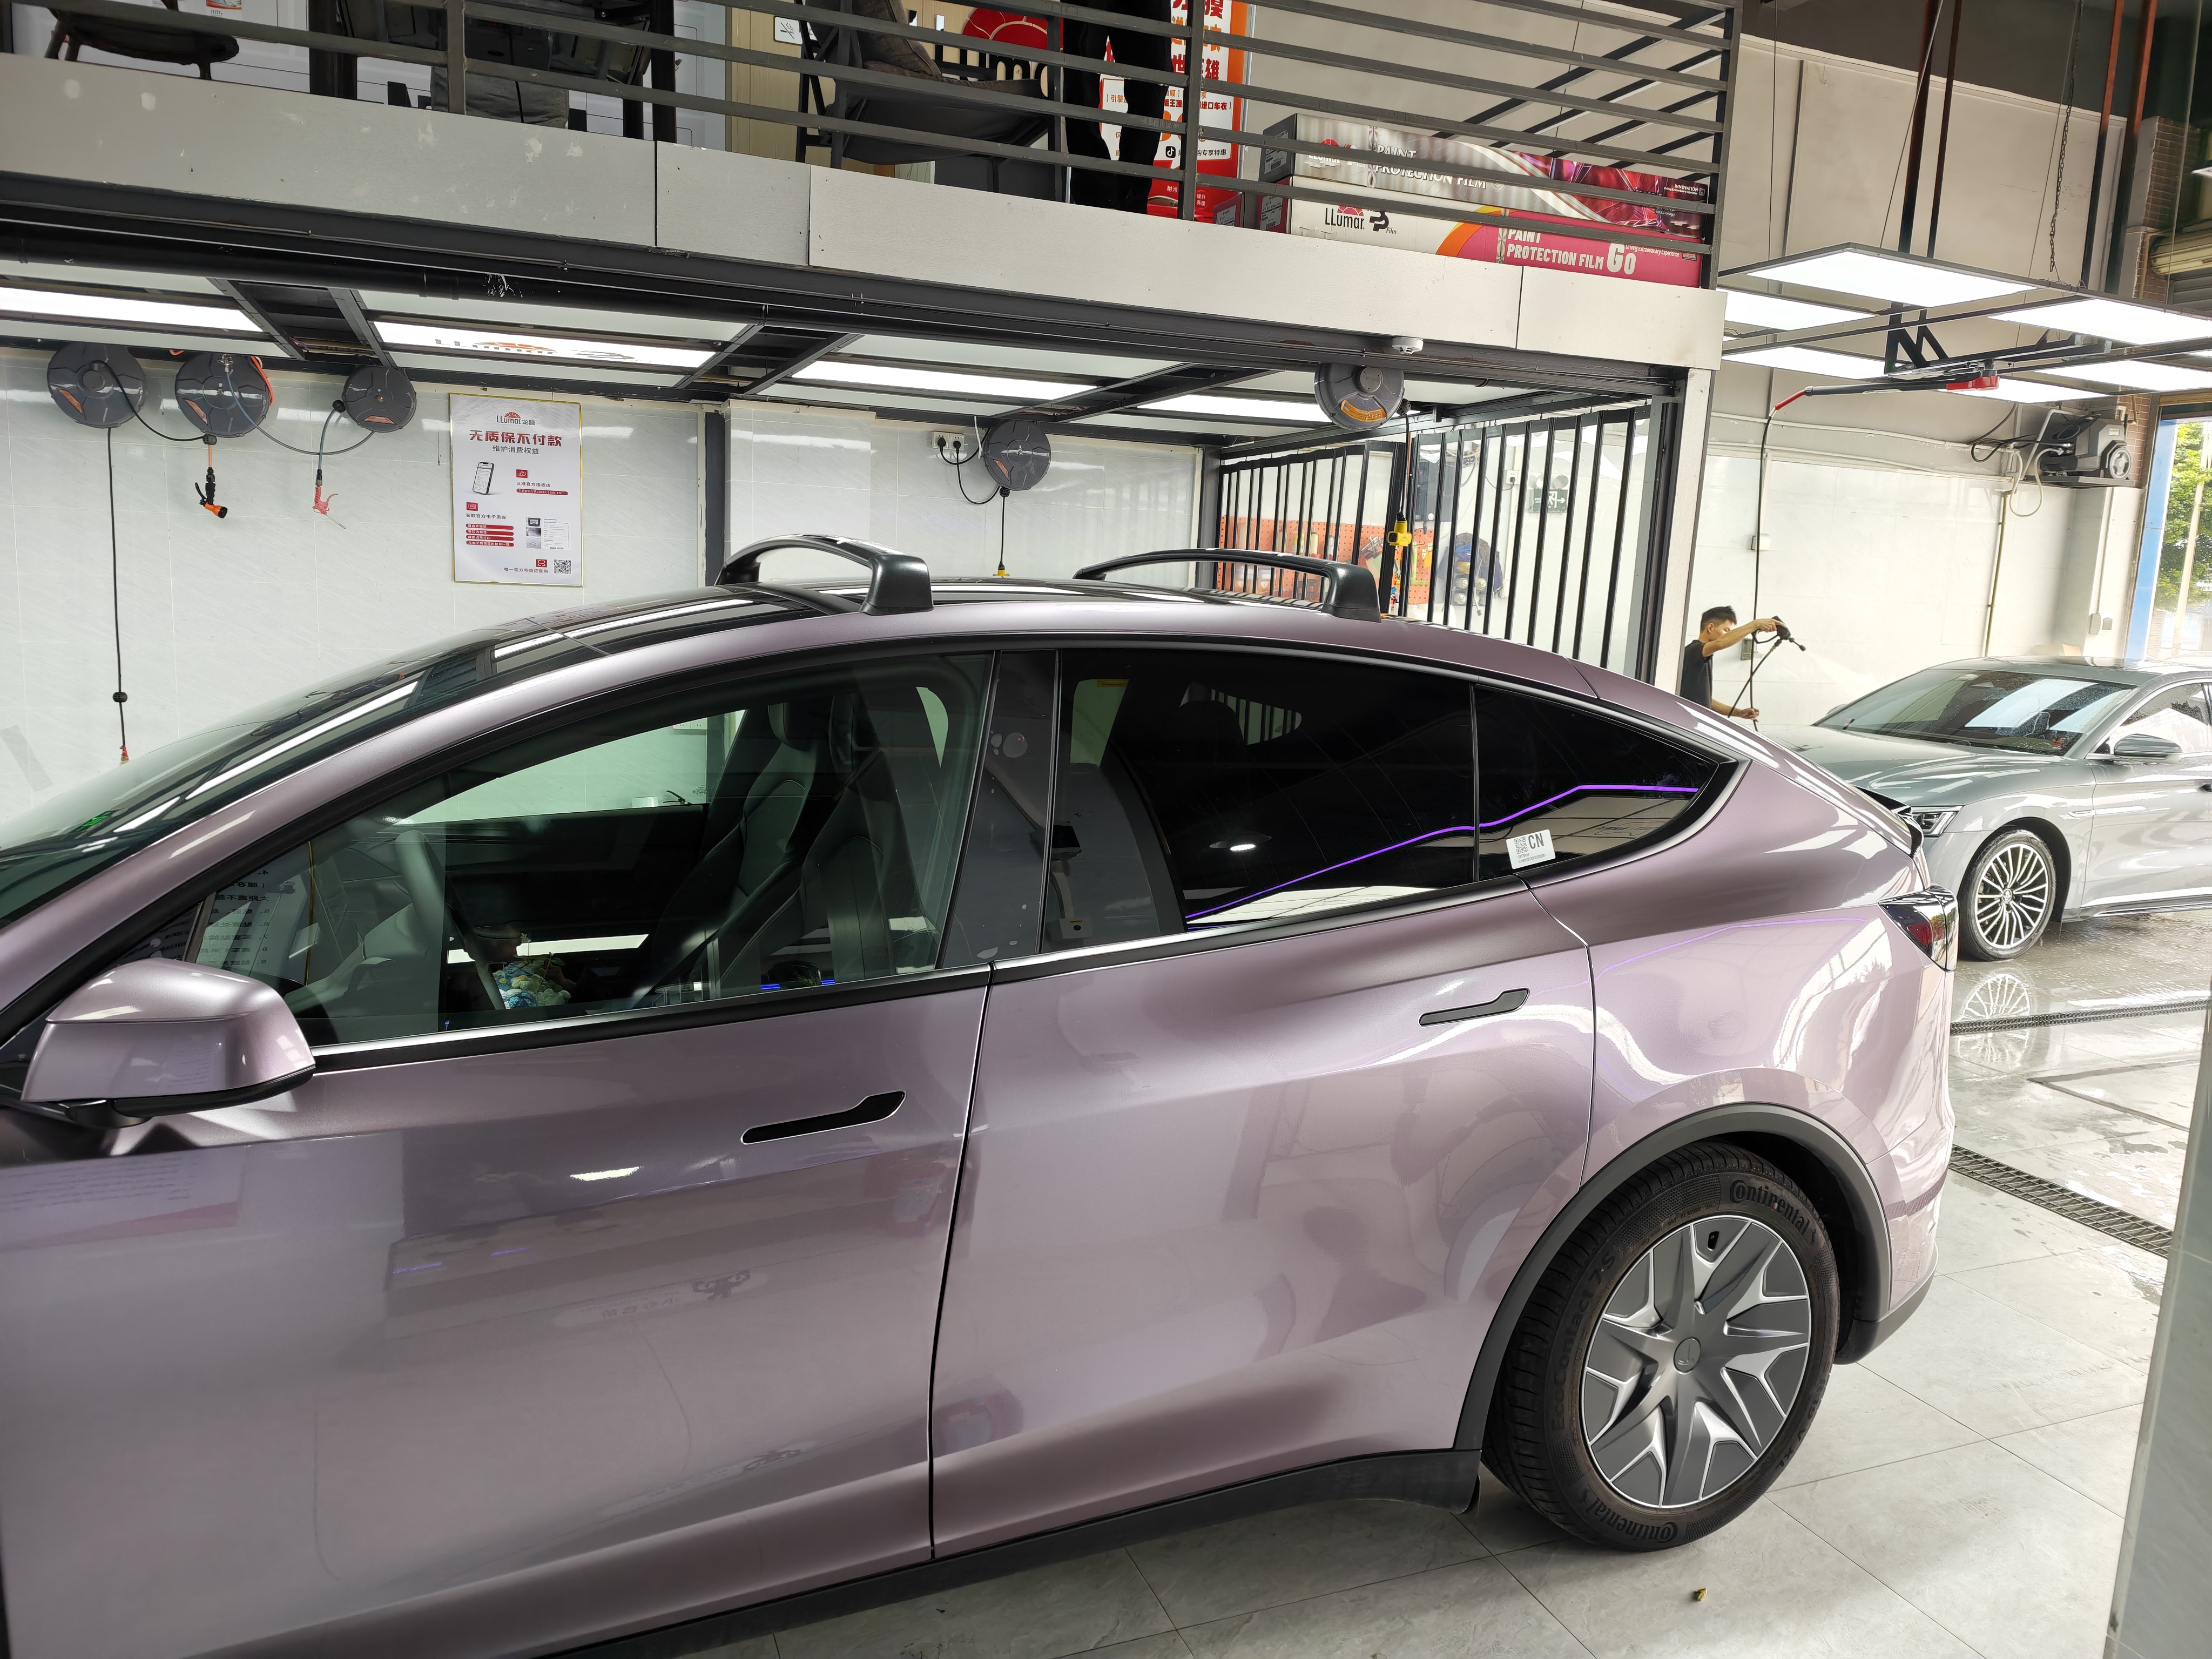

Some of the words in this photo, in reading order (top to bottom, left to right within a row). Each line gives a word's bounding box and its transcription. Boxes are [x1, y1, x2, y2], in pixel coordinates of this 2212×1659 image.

[1674, 184, 1698, 192] INNOVATION
[1325, 207, 1365, 230] LLumar
[1386, 226, 1397, 235] Film
[1506, 244, 1579, 267] PROTECTION
[1579, 253, 1604, 271] FILM
[1661, 249, 1680, 257] Experience
[496, 415, 521, 425] LLumar
[469, 429, 562, 447] 无质保不付款
[492, 444, 539, 454] 维护消费权益
[1528, 832, 1545, 849] CN
[1730, 1180, 1810, 1236] Continental
[1585, 1496, 1678, 1543] Continental
